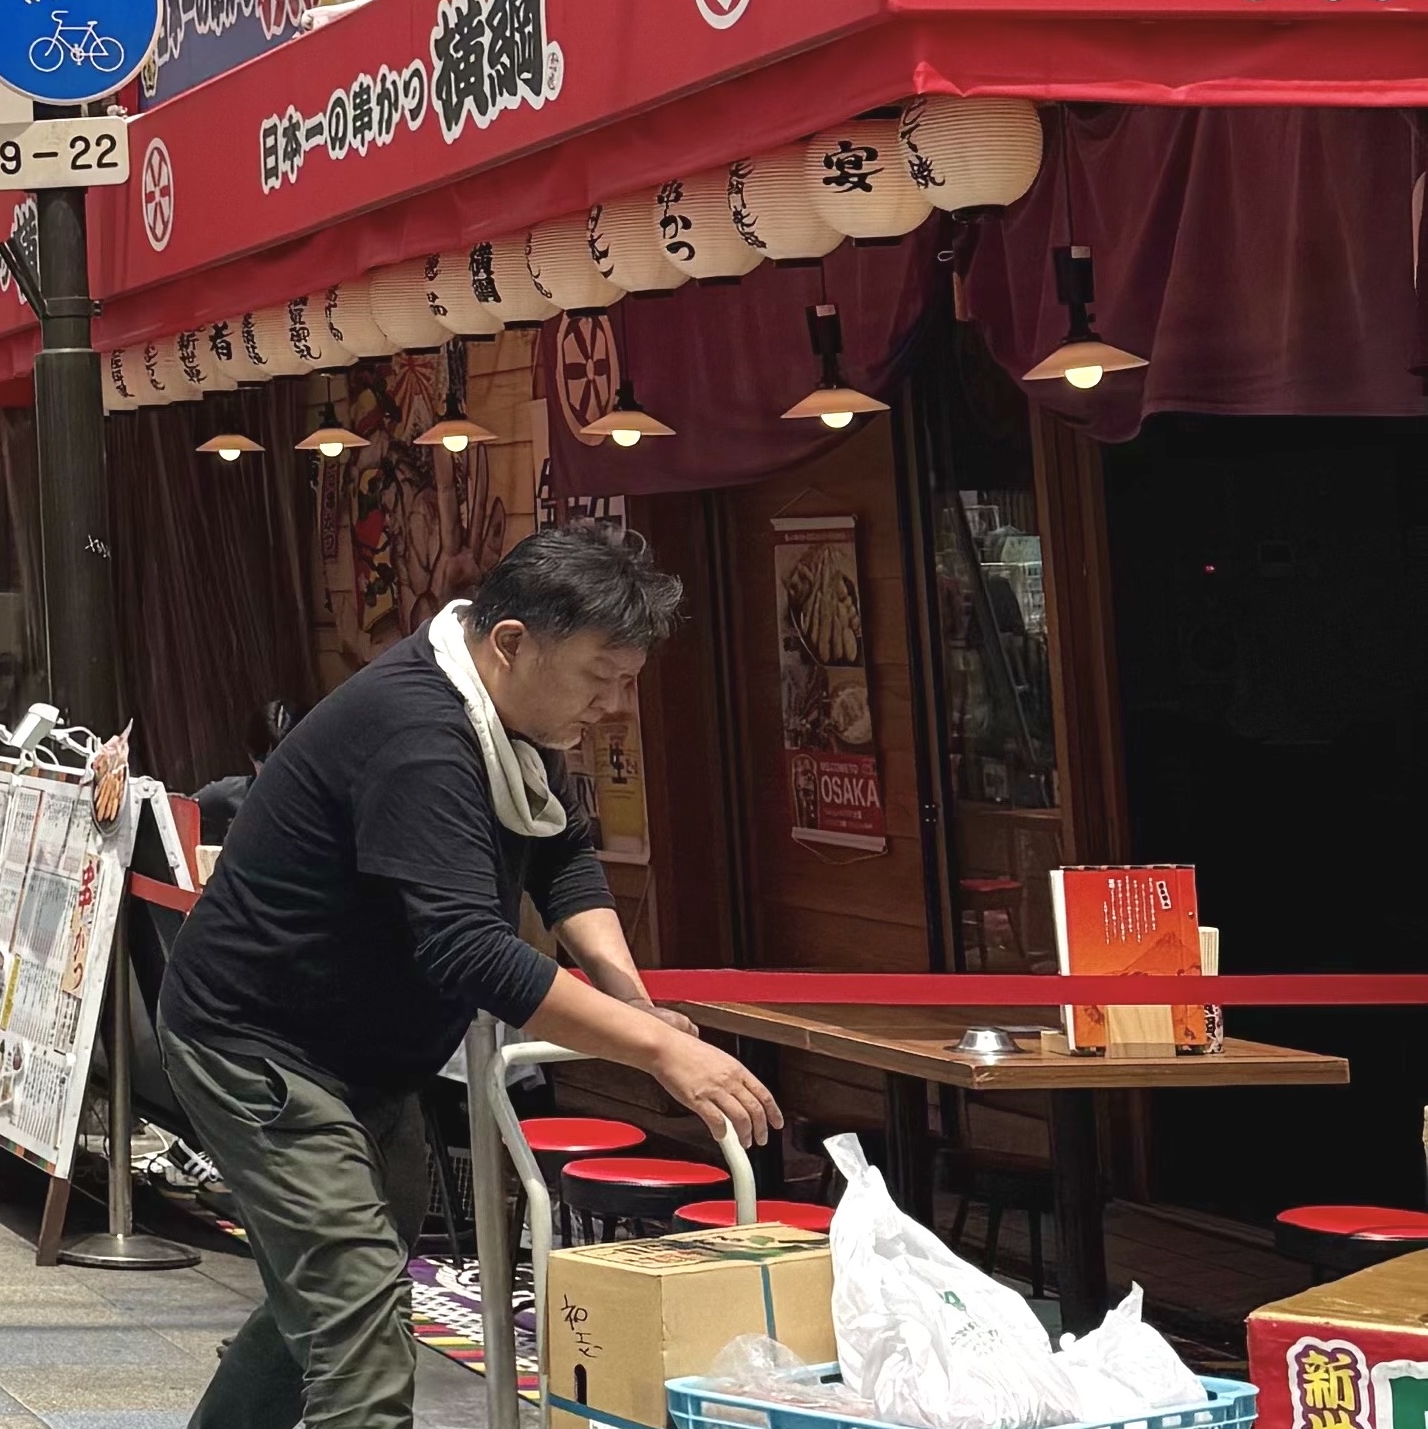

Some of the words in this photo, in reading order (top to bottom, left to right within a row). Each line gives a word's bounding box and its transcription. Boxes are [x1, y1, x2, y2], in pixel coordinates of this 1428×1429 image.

[264, 63, 426, 188] 日本一の串かつ
[0, 134, 119, 174] 9-22
[822, 140, 883, 193] 宴
[656, 178, 695, 262] 串かつ
[821, 774, 879, 809] OSAKA
